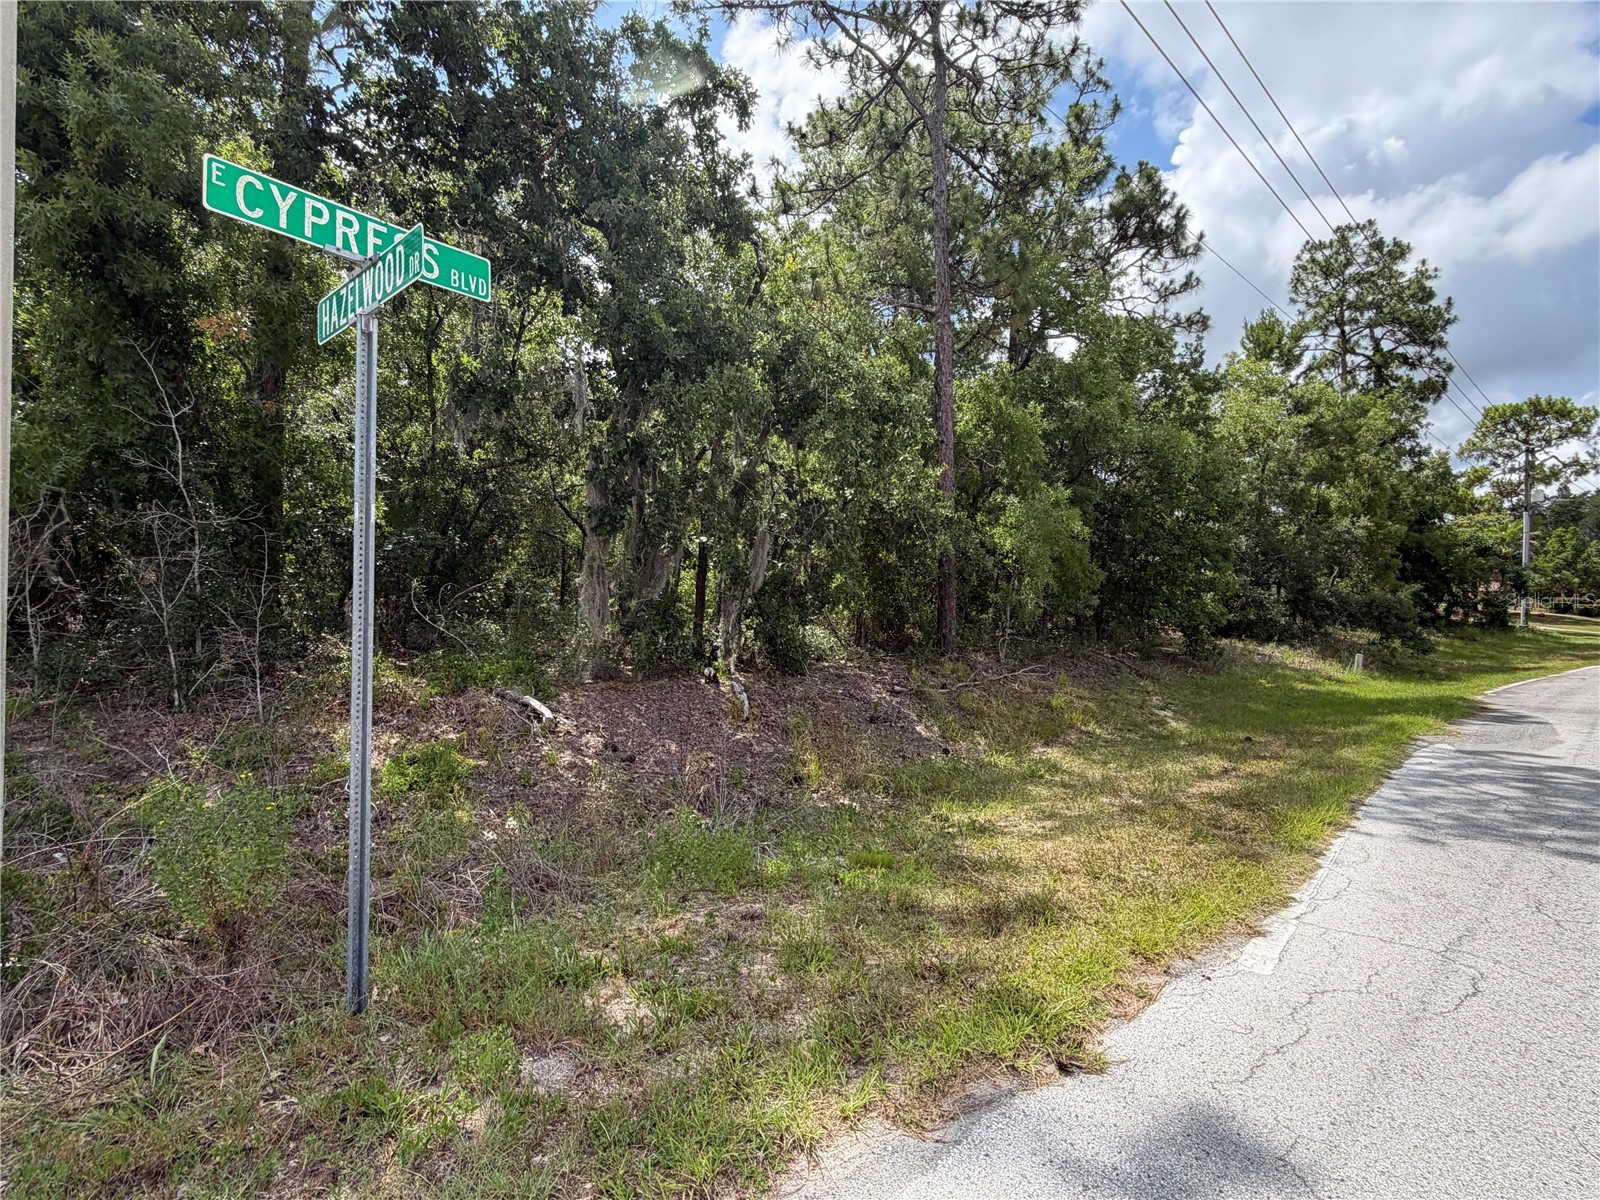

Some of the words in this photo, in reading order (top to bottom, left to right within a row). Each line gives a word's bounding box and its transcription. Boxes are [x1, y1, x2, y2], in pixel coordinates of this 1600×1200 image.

[211, 161, 226, 187] E
[235, 174, 440, 279] CYPRES
[450, 268, 487, 296] BLVD
[321, 244, 405, 338] HAZELWOOD
[409, 251, 420, 278] DR
